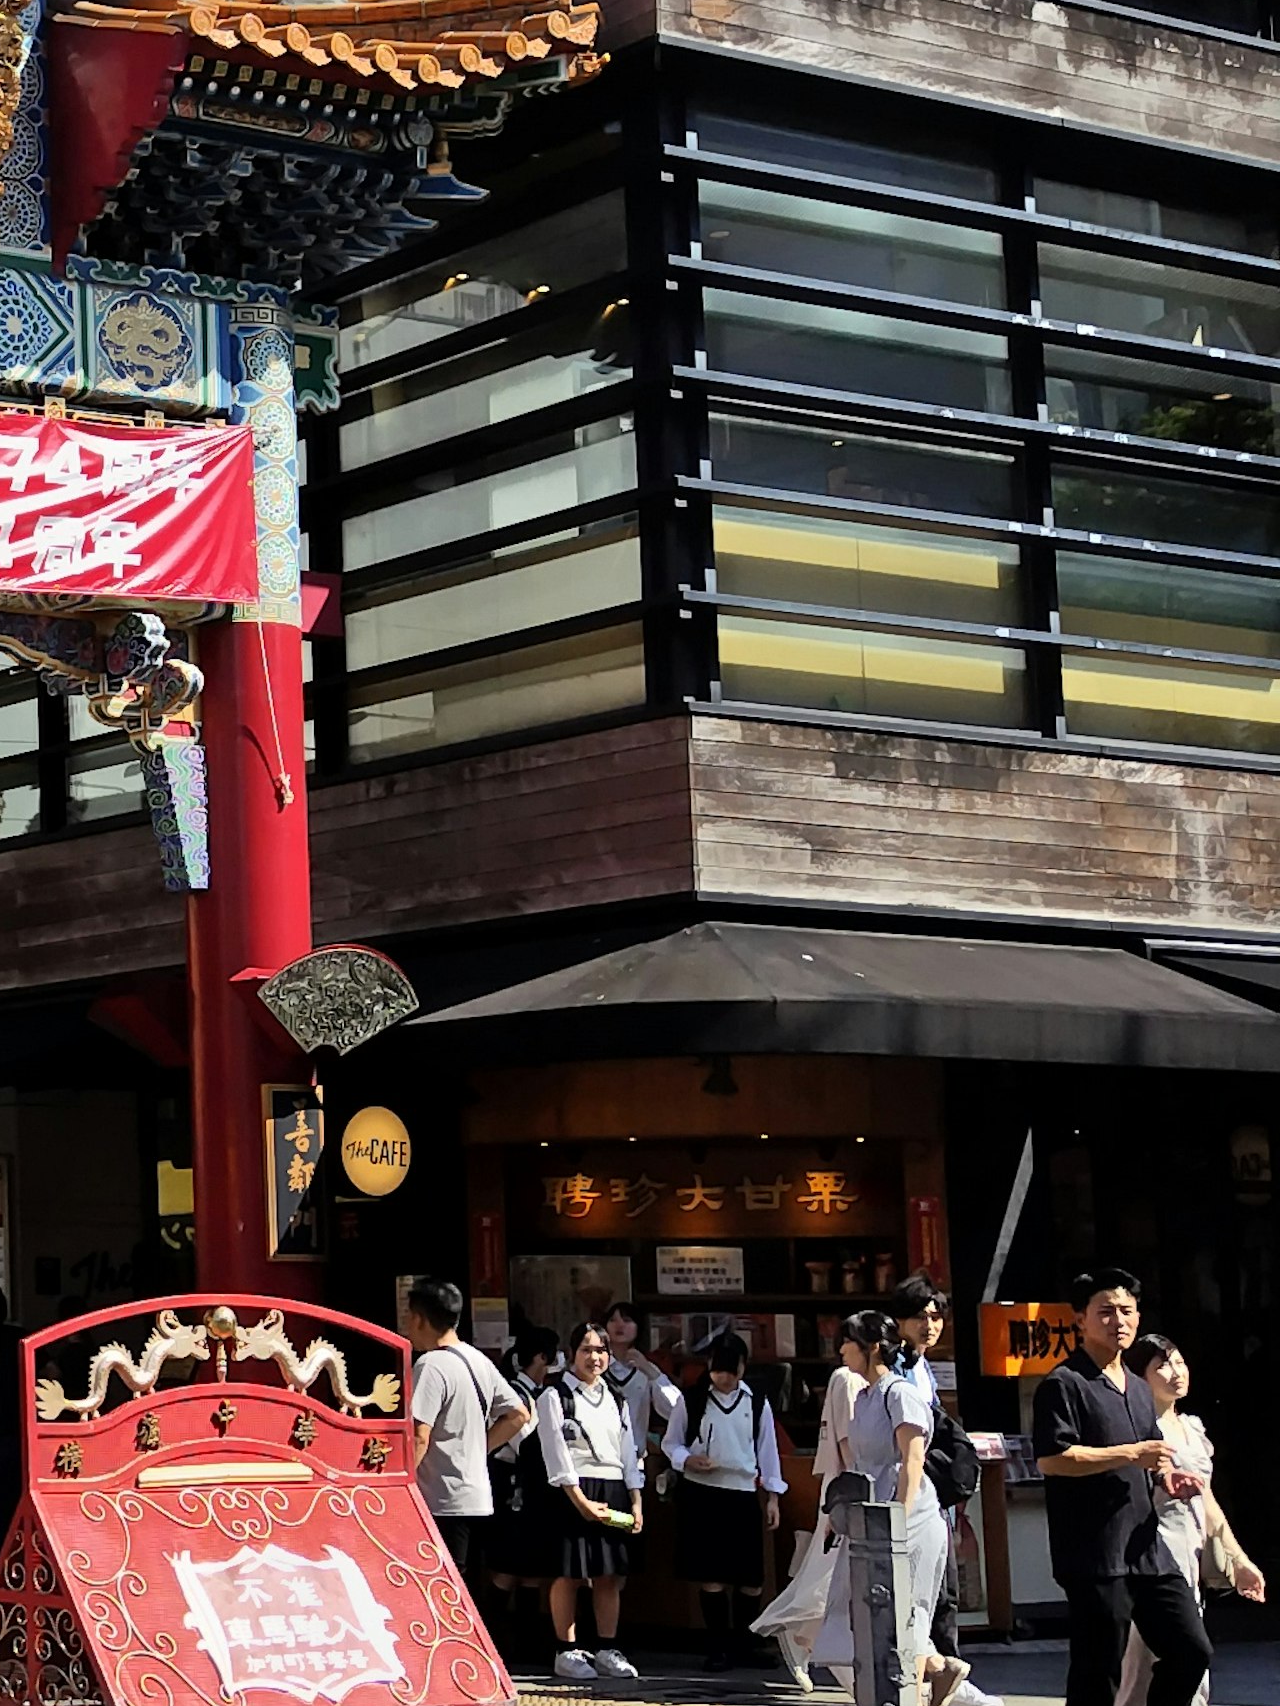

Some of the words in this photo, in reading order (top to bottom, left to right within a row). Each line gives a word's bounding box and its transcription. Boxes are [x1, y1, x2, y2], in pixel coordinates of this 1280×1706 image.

[345, 1140, 373, 1160] The
[369, 1138, 408, 1168] CAFE
[541, 1170, 859, 1219] 聘珍大甘栗
[234, 1577, 323, 1608] 不准
